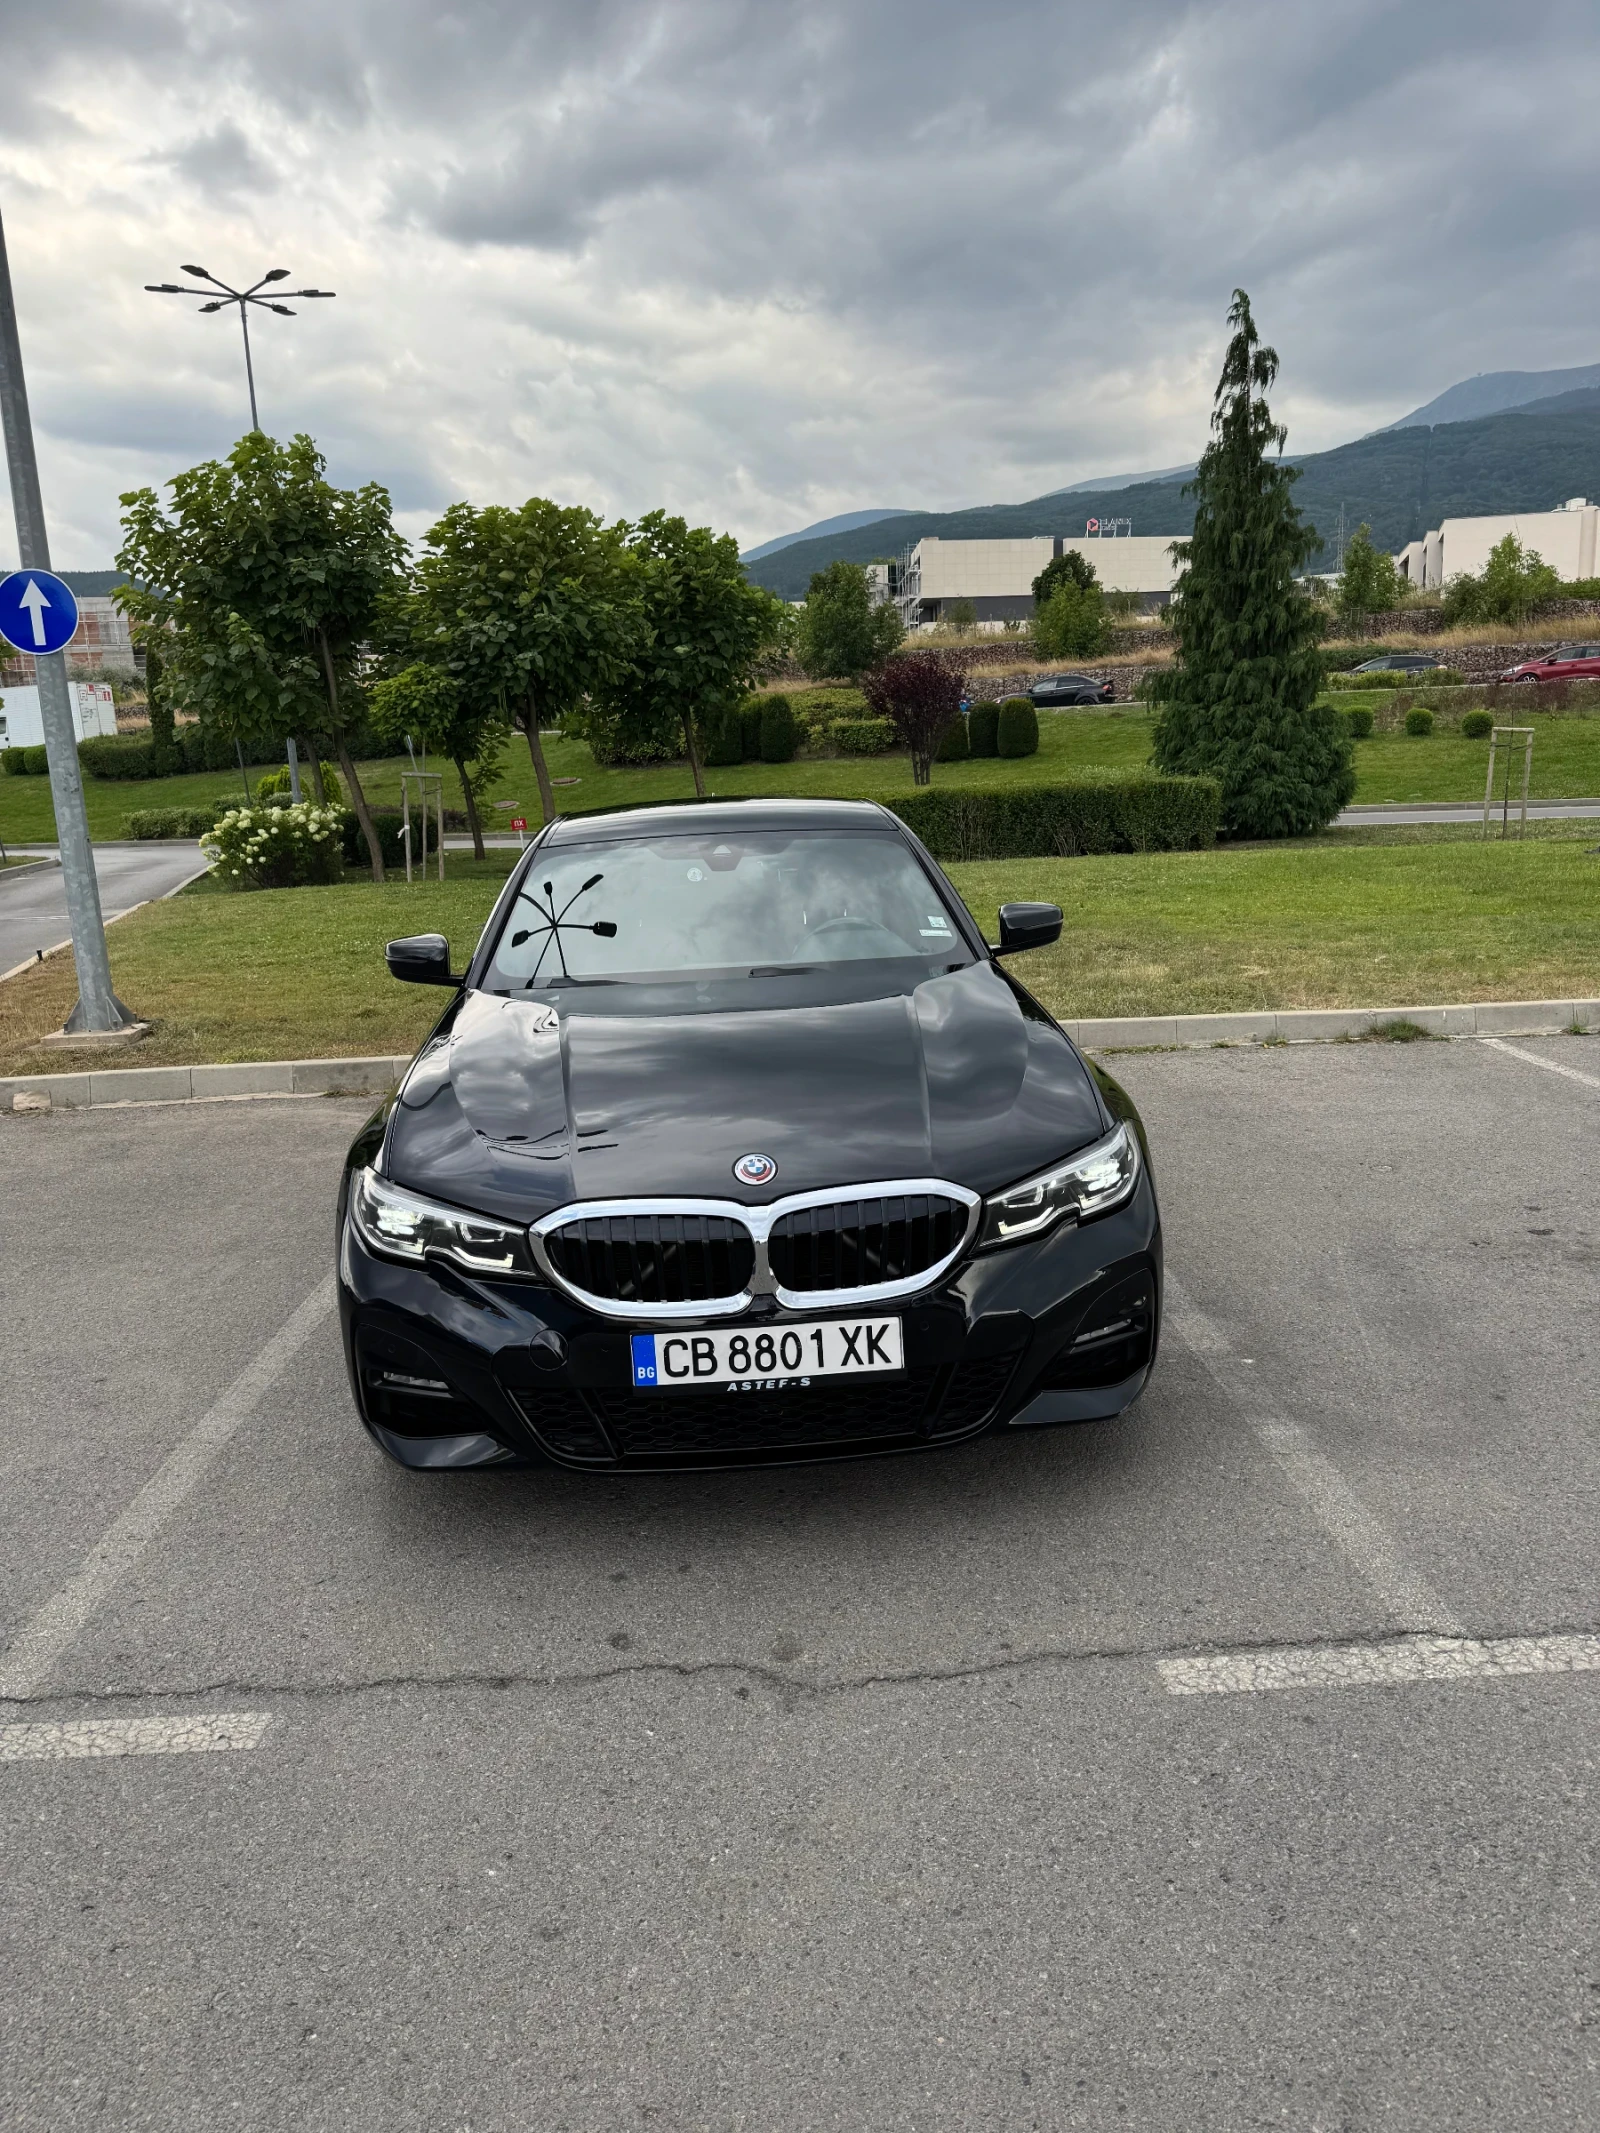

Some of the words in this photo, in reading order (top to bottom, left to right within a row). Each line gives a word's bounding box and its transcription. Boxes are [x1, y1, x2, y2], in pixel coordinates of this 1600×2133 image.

[663, 1337, 718, 1378] CB
[728, 1328, 825, 1374] 8801
[838, 1324, 892, 1367] XK
[637, 1366, 655, 1379] BG
[726, 1377, 811, 1392] ASTEF-S
